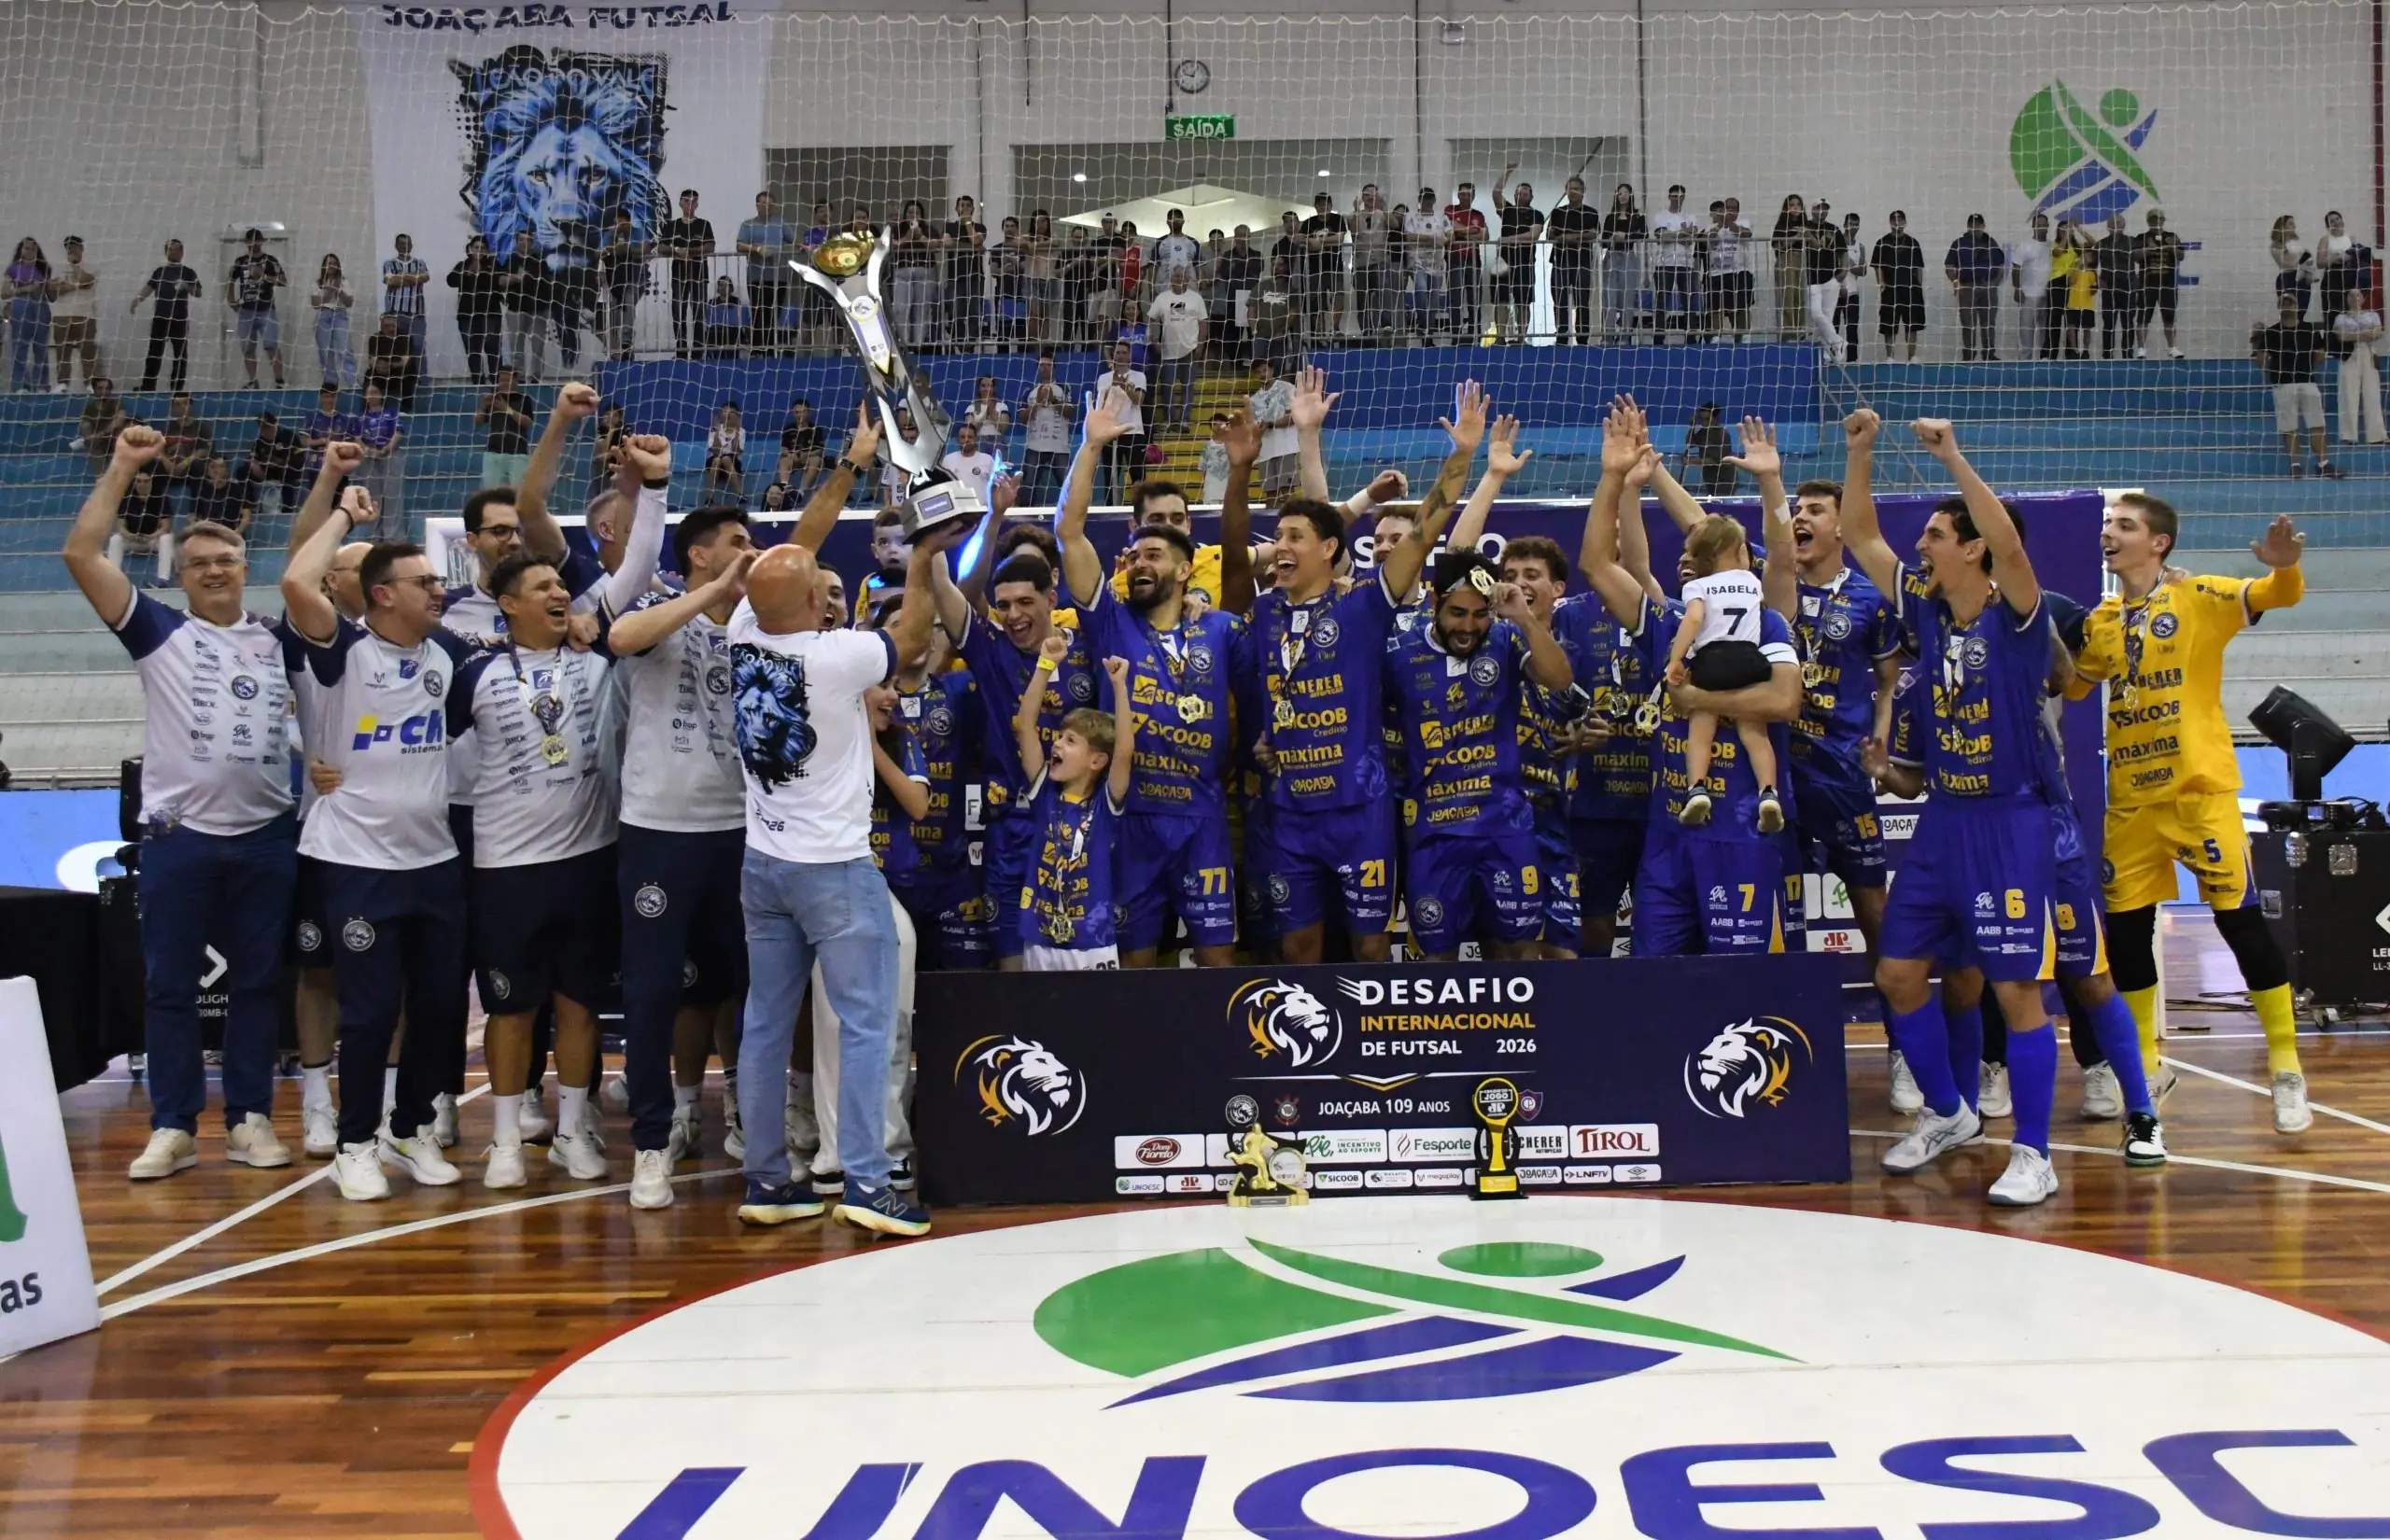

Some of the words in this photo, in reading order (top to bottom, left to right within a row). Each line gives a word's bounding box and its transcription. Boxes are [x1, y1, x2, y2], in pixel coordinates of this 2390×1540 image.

[383, 3, 576, 35] JOAÇABA
[588, 1, 738, 29] FUTSAL
[1174, 119, 1226, 137] SAÍDA
[1706, 584, 1758, 596] ISABELA
[1722, 608, 1748, 636] 7
[2122, 700, 2180, 726] SICOOB
[1147, 719, 1212, 749] SICOOB
[1276, 744, 1343, 763] máxima
[1594, 751, 1649, 766] máxim
[1667, 736, 1736, 759] SICOB
[2114, 735, 2179, 761] máxima
[1403, 799, 1417, 826] 9
[1854, 813, 1878, 839] 15
[2204, 838, 2221, 863] 5
[1199, 866, 1226, 895] 77
[1360, 859, 1385, 887] 21
[1522, 865, 1539, 894] 9
[1019, 887, 1033, 909] 6
[1738, 884, 1754, 911] 7
[2004, 889, 2026, 918] 6
[1359, 976, 1534, 1005] DESAFIO
[1360, 1013, 1536, 1031] INTERNACIONAL
[1361, 1042, 1386, 1056] DE
[1391, 1040, 1462, 1055] FUTSAL
[1496, 1039, 1537, 1054] 2026
[1318, 1100, 1380, 1118] JOAÇABA
[1385, 1099, 1413, 1113] 109
[1418, 1101, 1450, 1113] ANOS
[1152, 1142, 1172, 1151] Dom
[1414, 1139, 1471, 1153] Fesporte
[1577, 1127, 1651, 1154] TIROL
[1181, 1176, 1200, 1187] JP
[1329, 1174, 1358, 1183] SICOOB
[613, 1429, 2390, 1540] UNOESC
